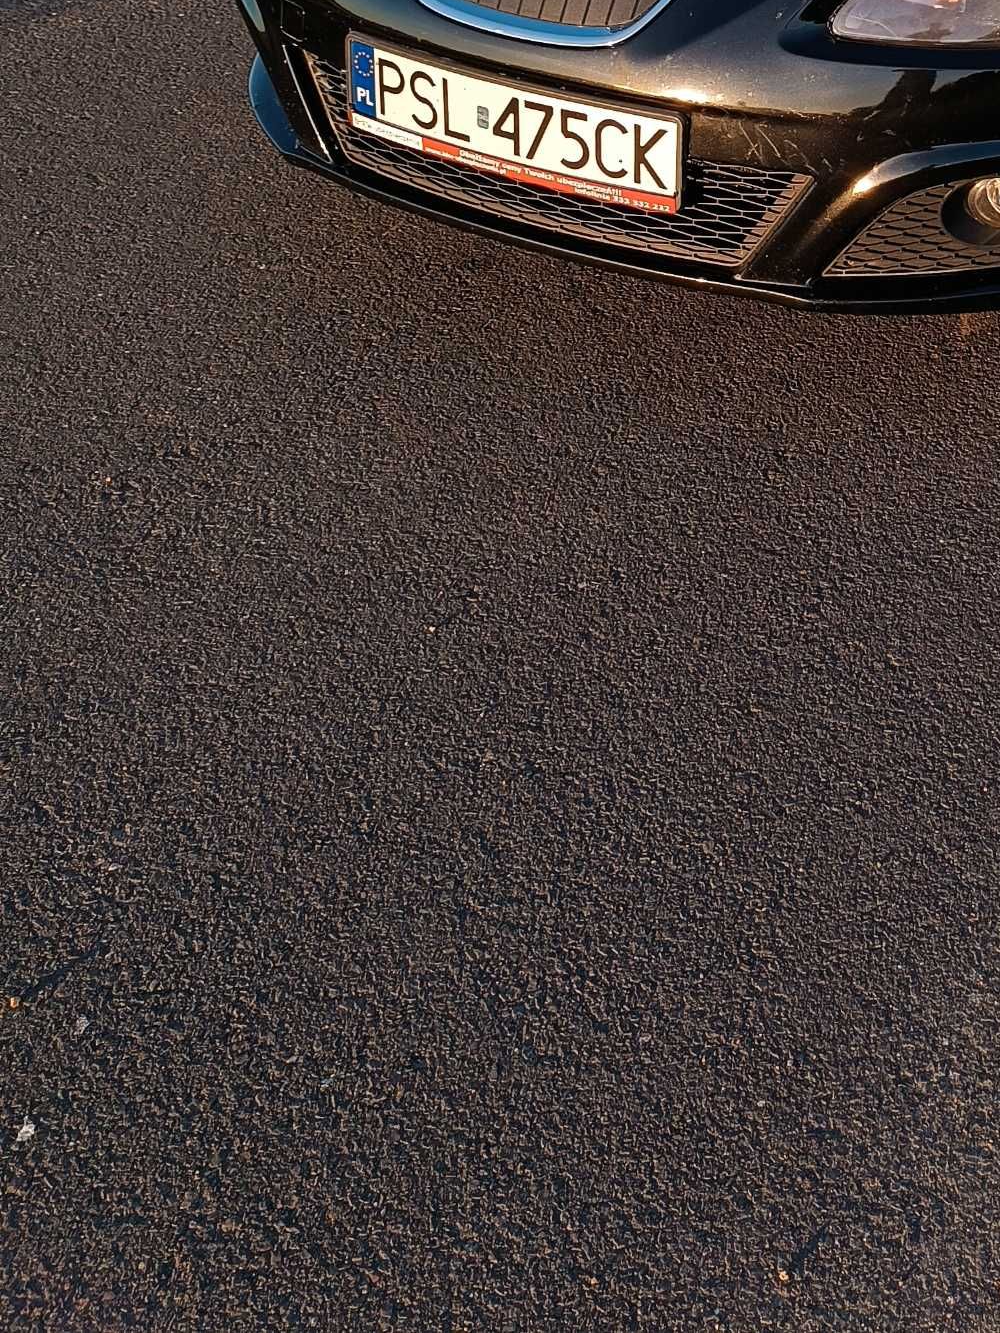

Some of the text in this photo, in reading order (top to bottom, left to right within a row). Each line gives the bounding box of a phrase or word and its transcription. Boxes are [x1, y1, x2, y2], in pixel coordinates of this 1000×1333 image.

[356, 86, 374, 106] PL
[378, 57, 668, 190] PSL 475CK
[524, 167, 555, 181] Twoich
